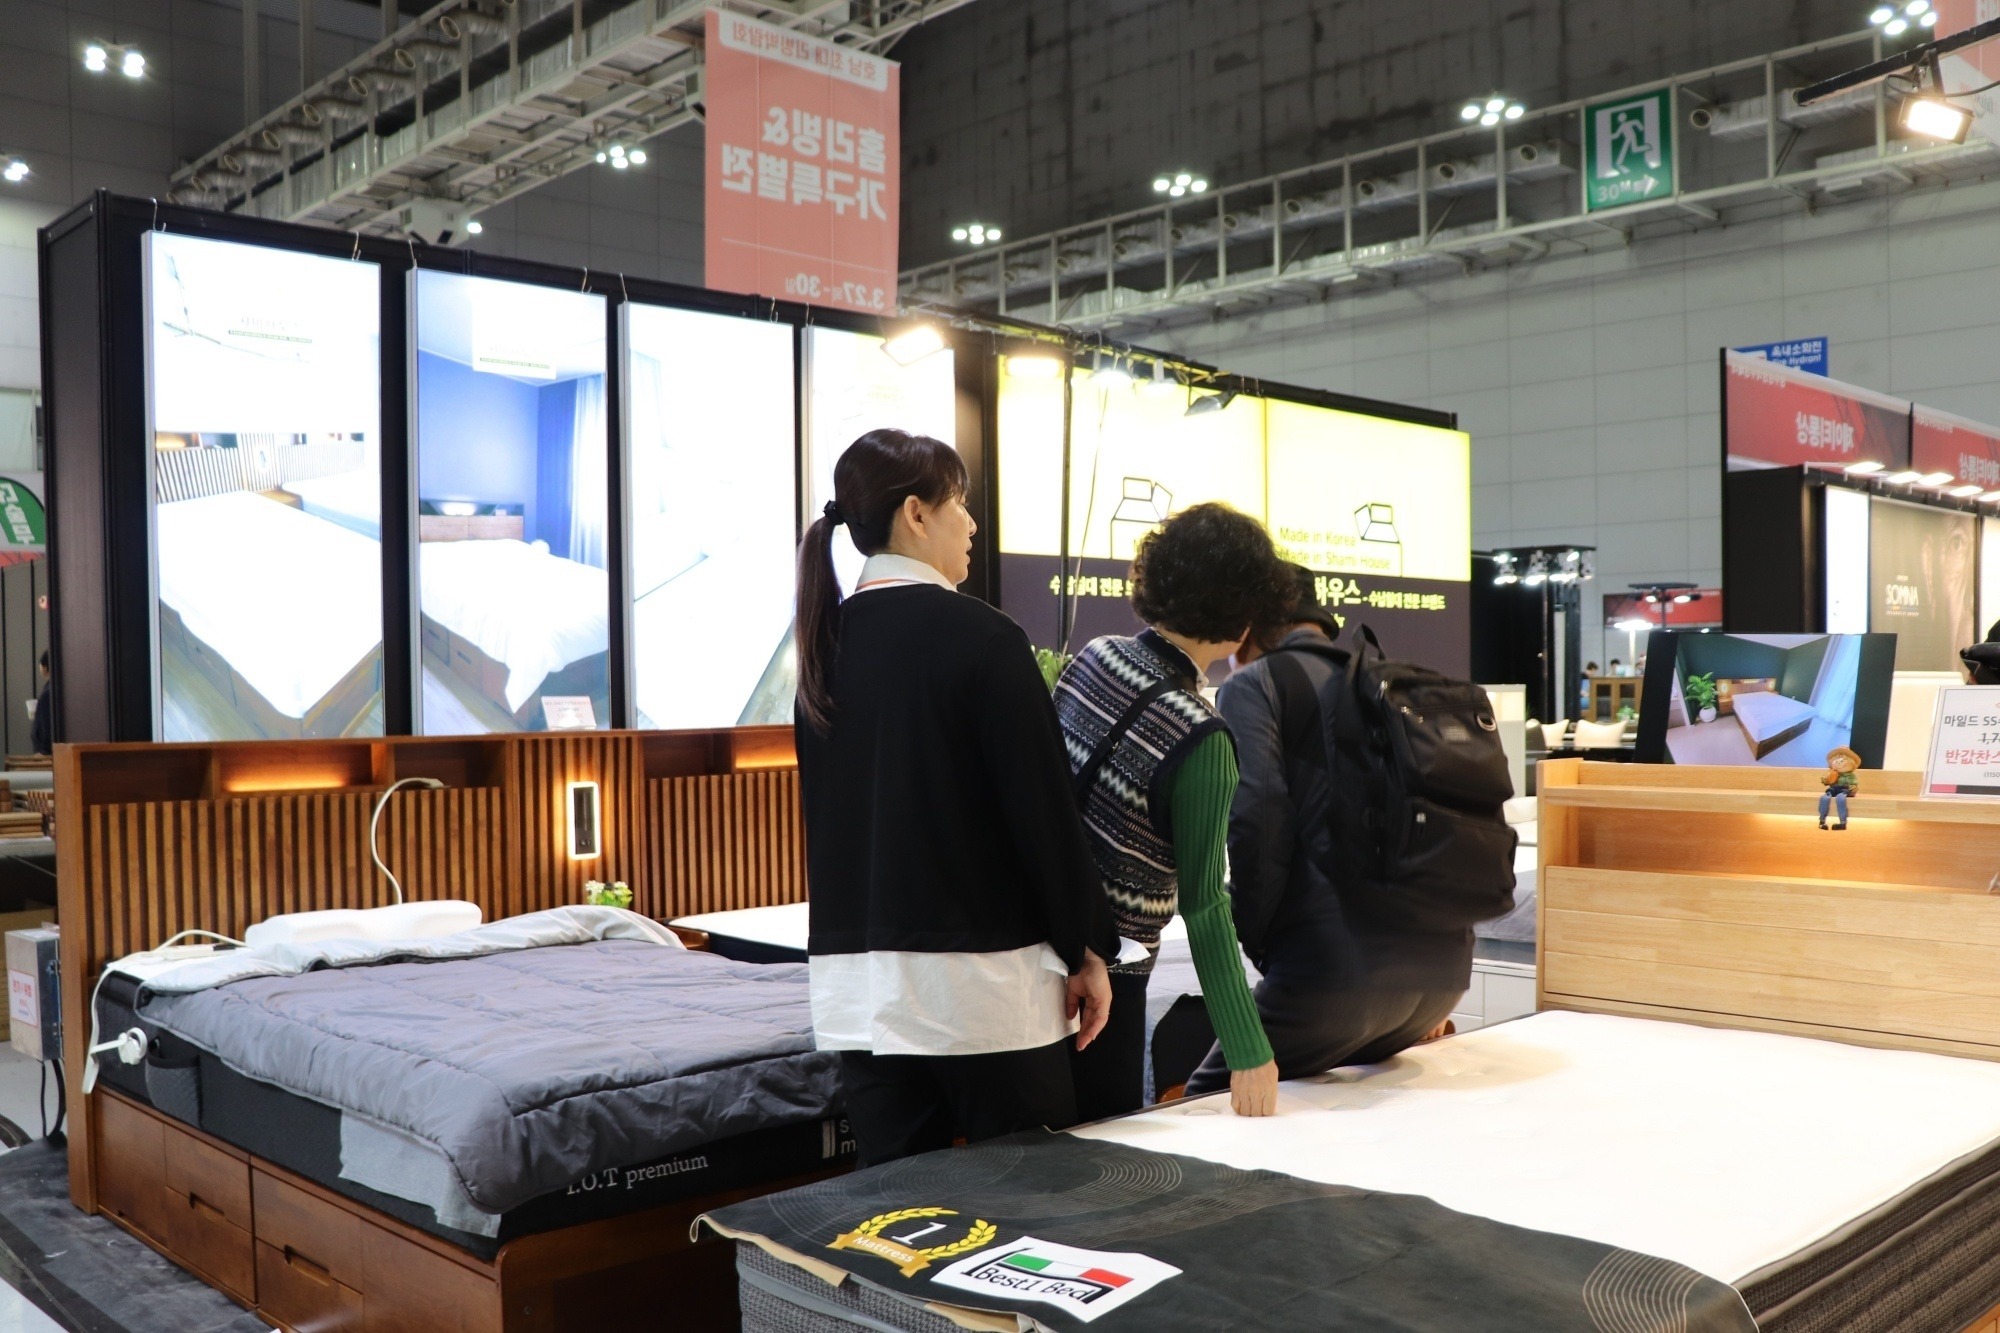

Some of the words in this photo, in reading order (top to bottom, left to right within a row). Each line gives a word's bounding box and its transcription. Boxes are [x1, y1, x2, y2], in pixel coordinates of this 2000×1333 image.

[1771, 340, 1822, 358] 옥내소화전
[1280, 527, 1309, 542] Made
[1313, 532, 1322, 543] in
[1326, 533, 1356, 547] Korea
[1361, 556, 1391, 569] House
[1944, 715, 1979, 727] 마일드
[1982, 715, 2000, 727] SS
[1981, 732, 2000, 745] 1,7
[626, 1155, 709, 1190] premium
[891, 1221, 948, 1245] 1
[853, 1235, 916, 1263] Mattress
[1044, 1276, 1092, 1301] Bed
